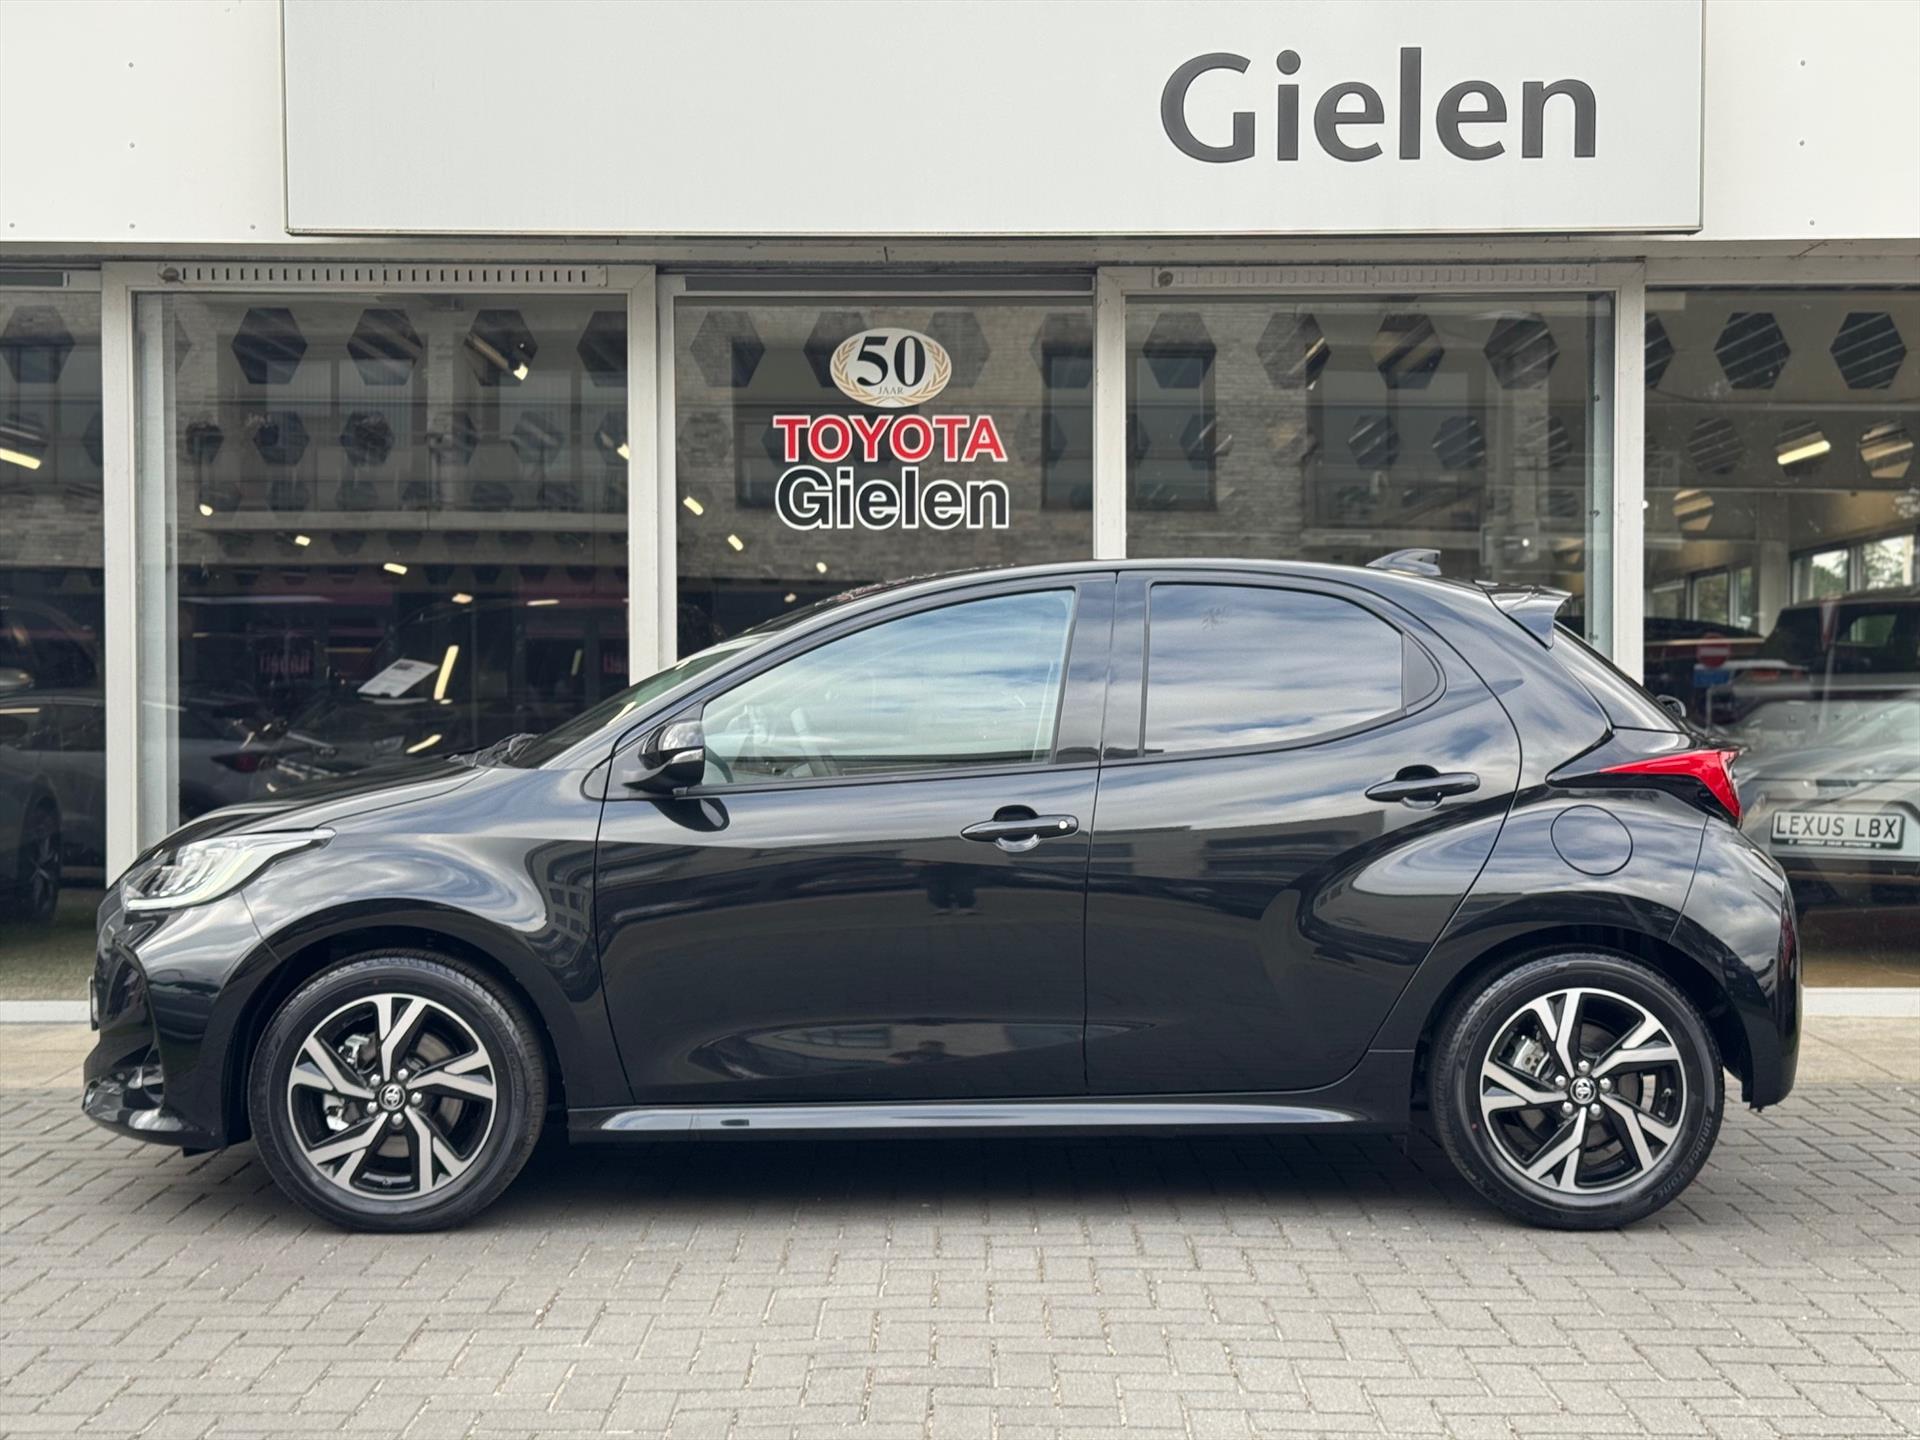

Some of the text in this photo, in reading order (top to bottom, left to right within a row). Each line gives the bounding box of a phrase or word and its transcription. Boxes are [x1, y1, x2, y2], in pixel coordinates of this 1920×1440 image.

[1161, 46, 1597, 163] Gielen
[856, 335, 926, 387] 50
[878, 386, 904, 396] JAAR
[773, 415, 1007, 462] TOYOTA
[775, 466, 1010, 530] Gielen
[1775, 814, 1897, 840] LEXUS LBX
